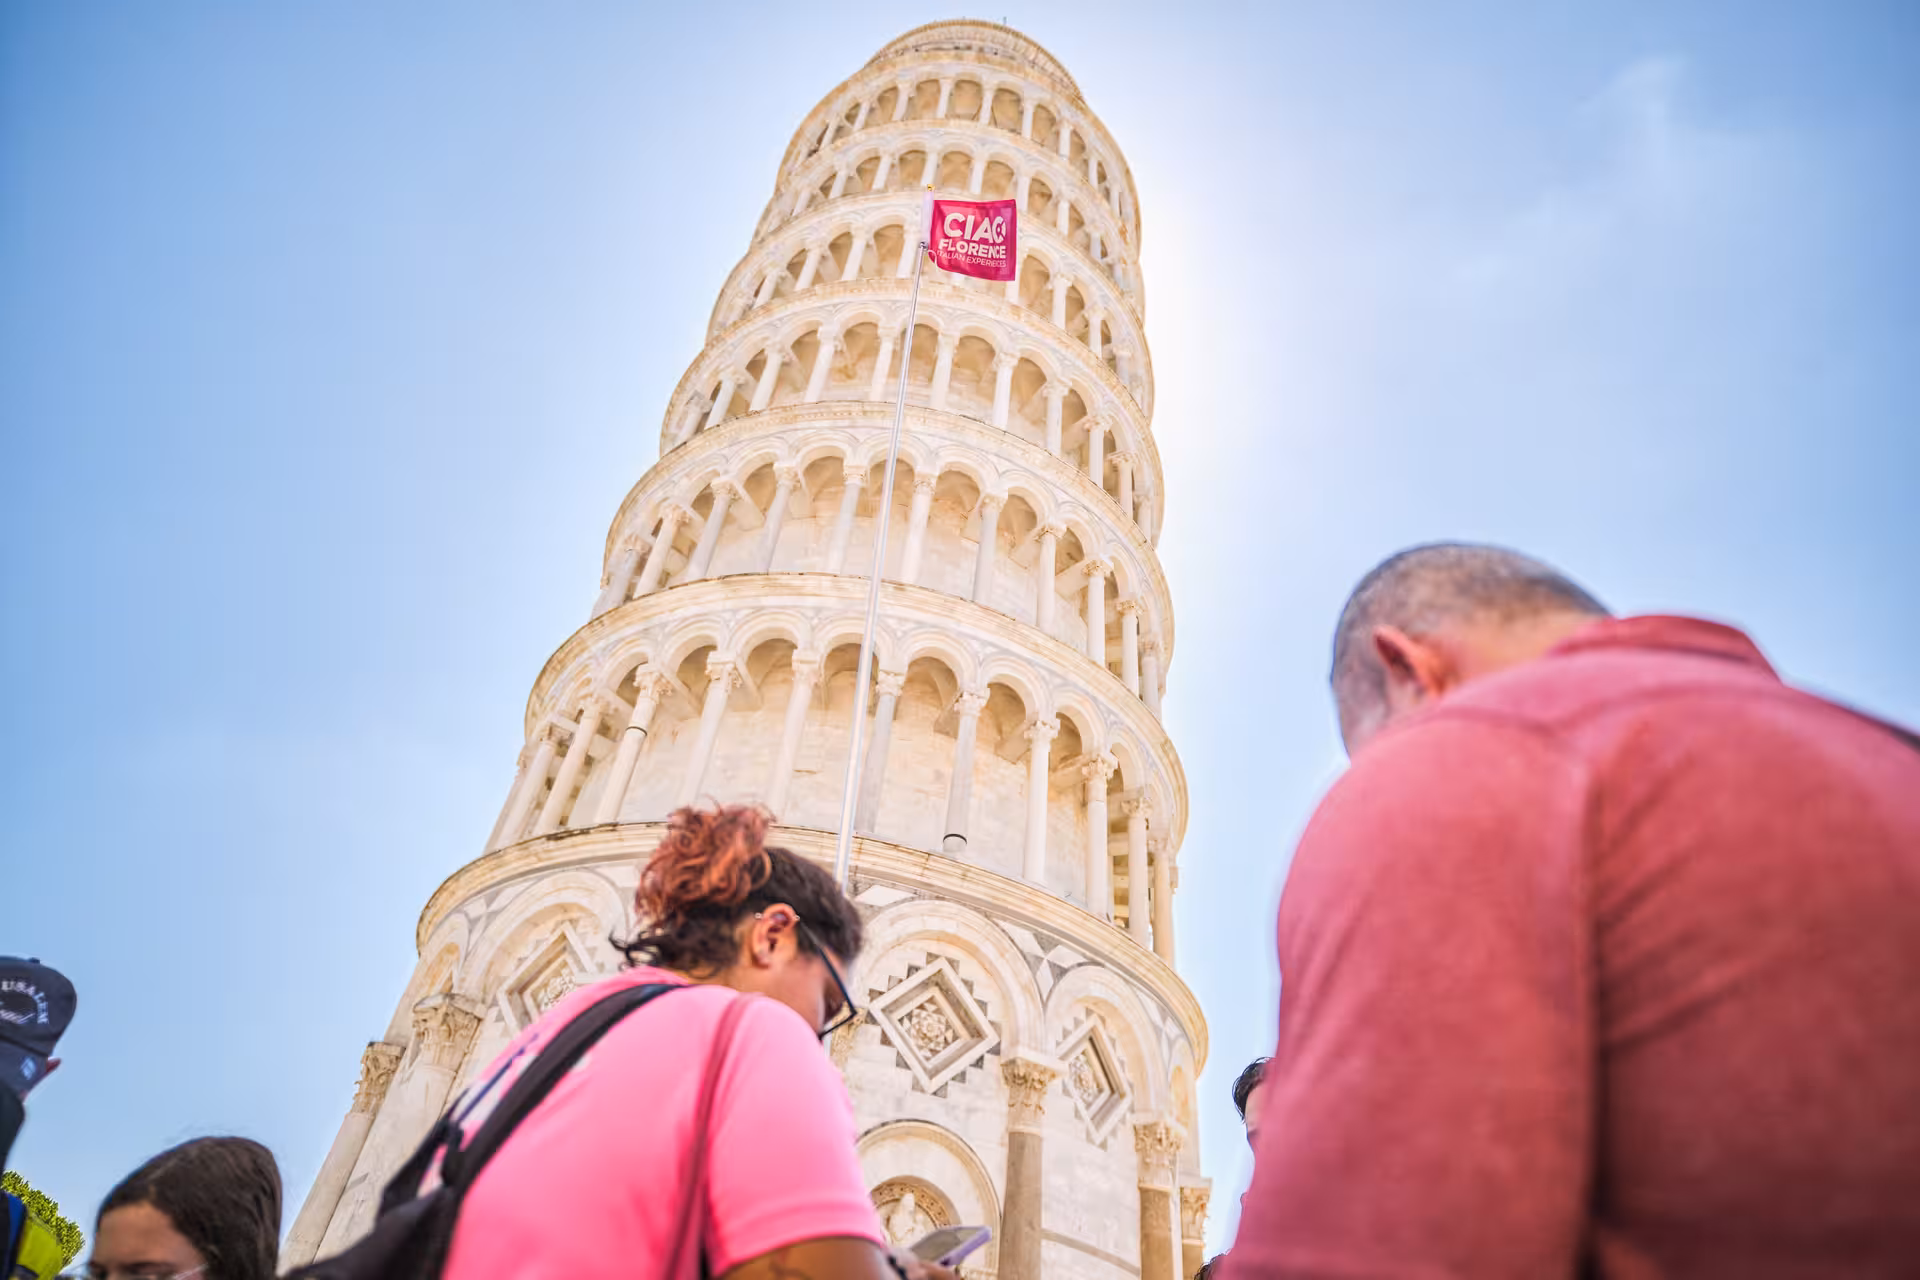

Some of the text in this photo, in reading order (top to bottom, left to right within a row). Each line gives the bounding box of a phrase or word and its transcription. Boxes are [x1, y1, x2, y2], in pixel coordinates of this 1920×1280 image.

[944, 212, 1006, 243] CIAO
[937, 250, 965, 262] ITALIAN
[938, 238, 1006, 259] FLORENCE
